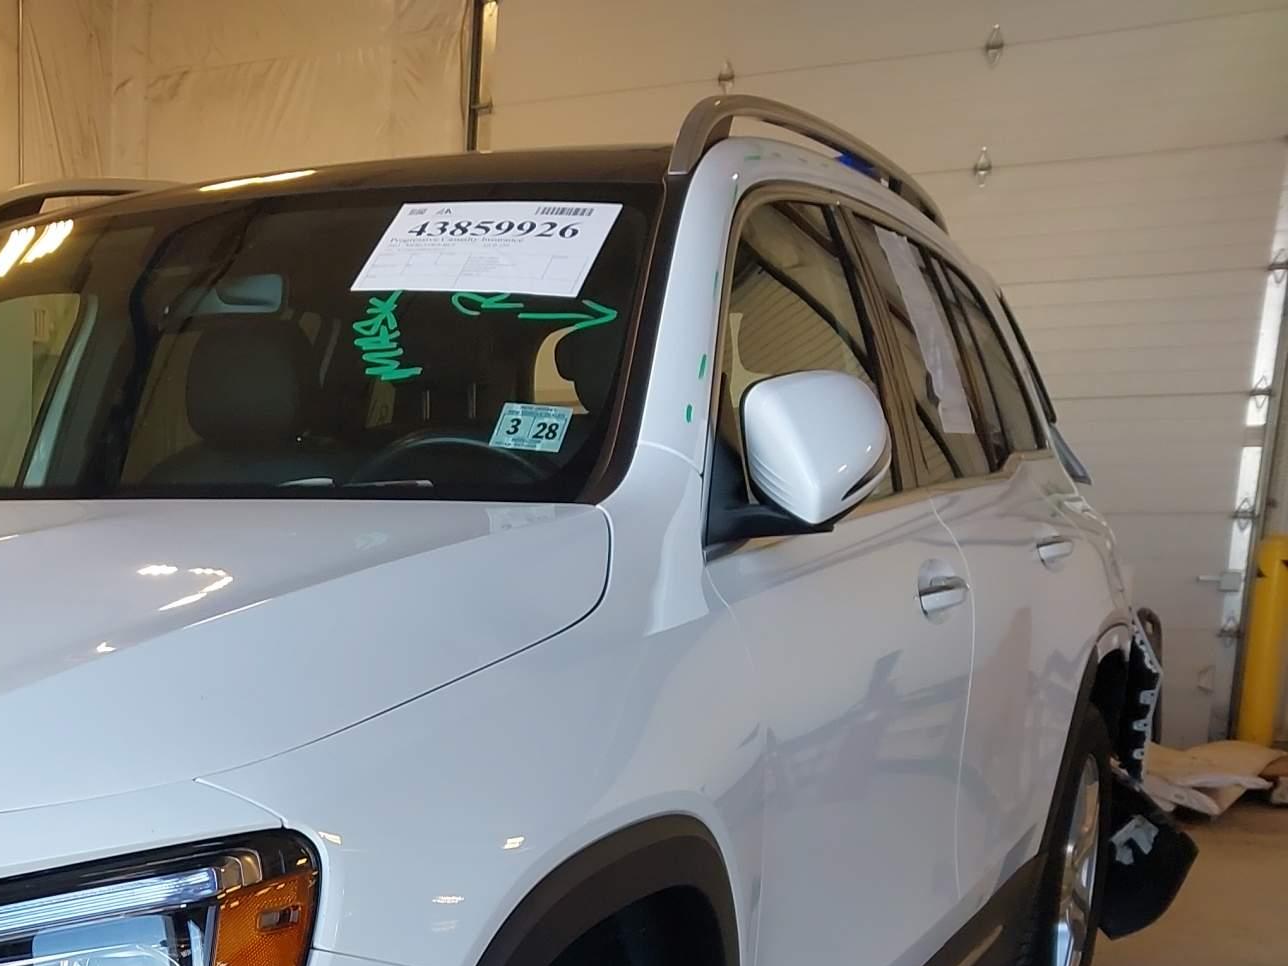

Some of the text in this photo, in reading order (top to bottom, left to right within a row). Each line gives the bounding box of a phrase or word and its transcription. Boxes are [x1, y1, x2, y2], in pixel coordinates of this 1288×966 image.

[408, 220, 583, 240] 43859926
[505, 418, 559, 440] 3 28
